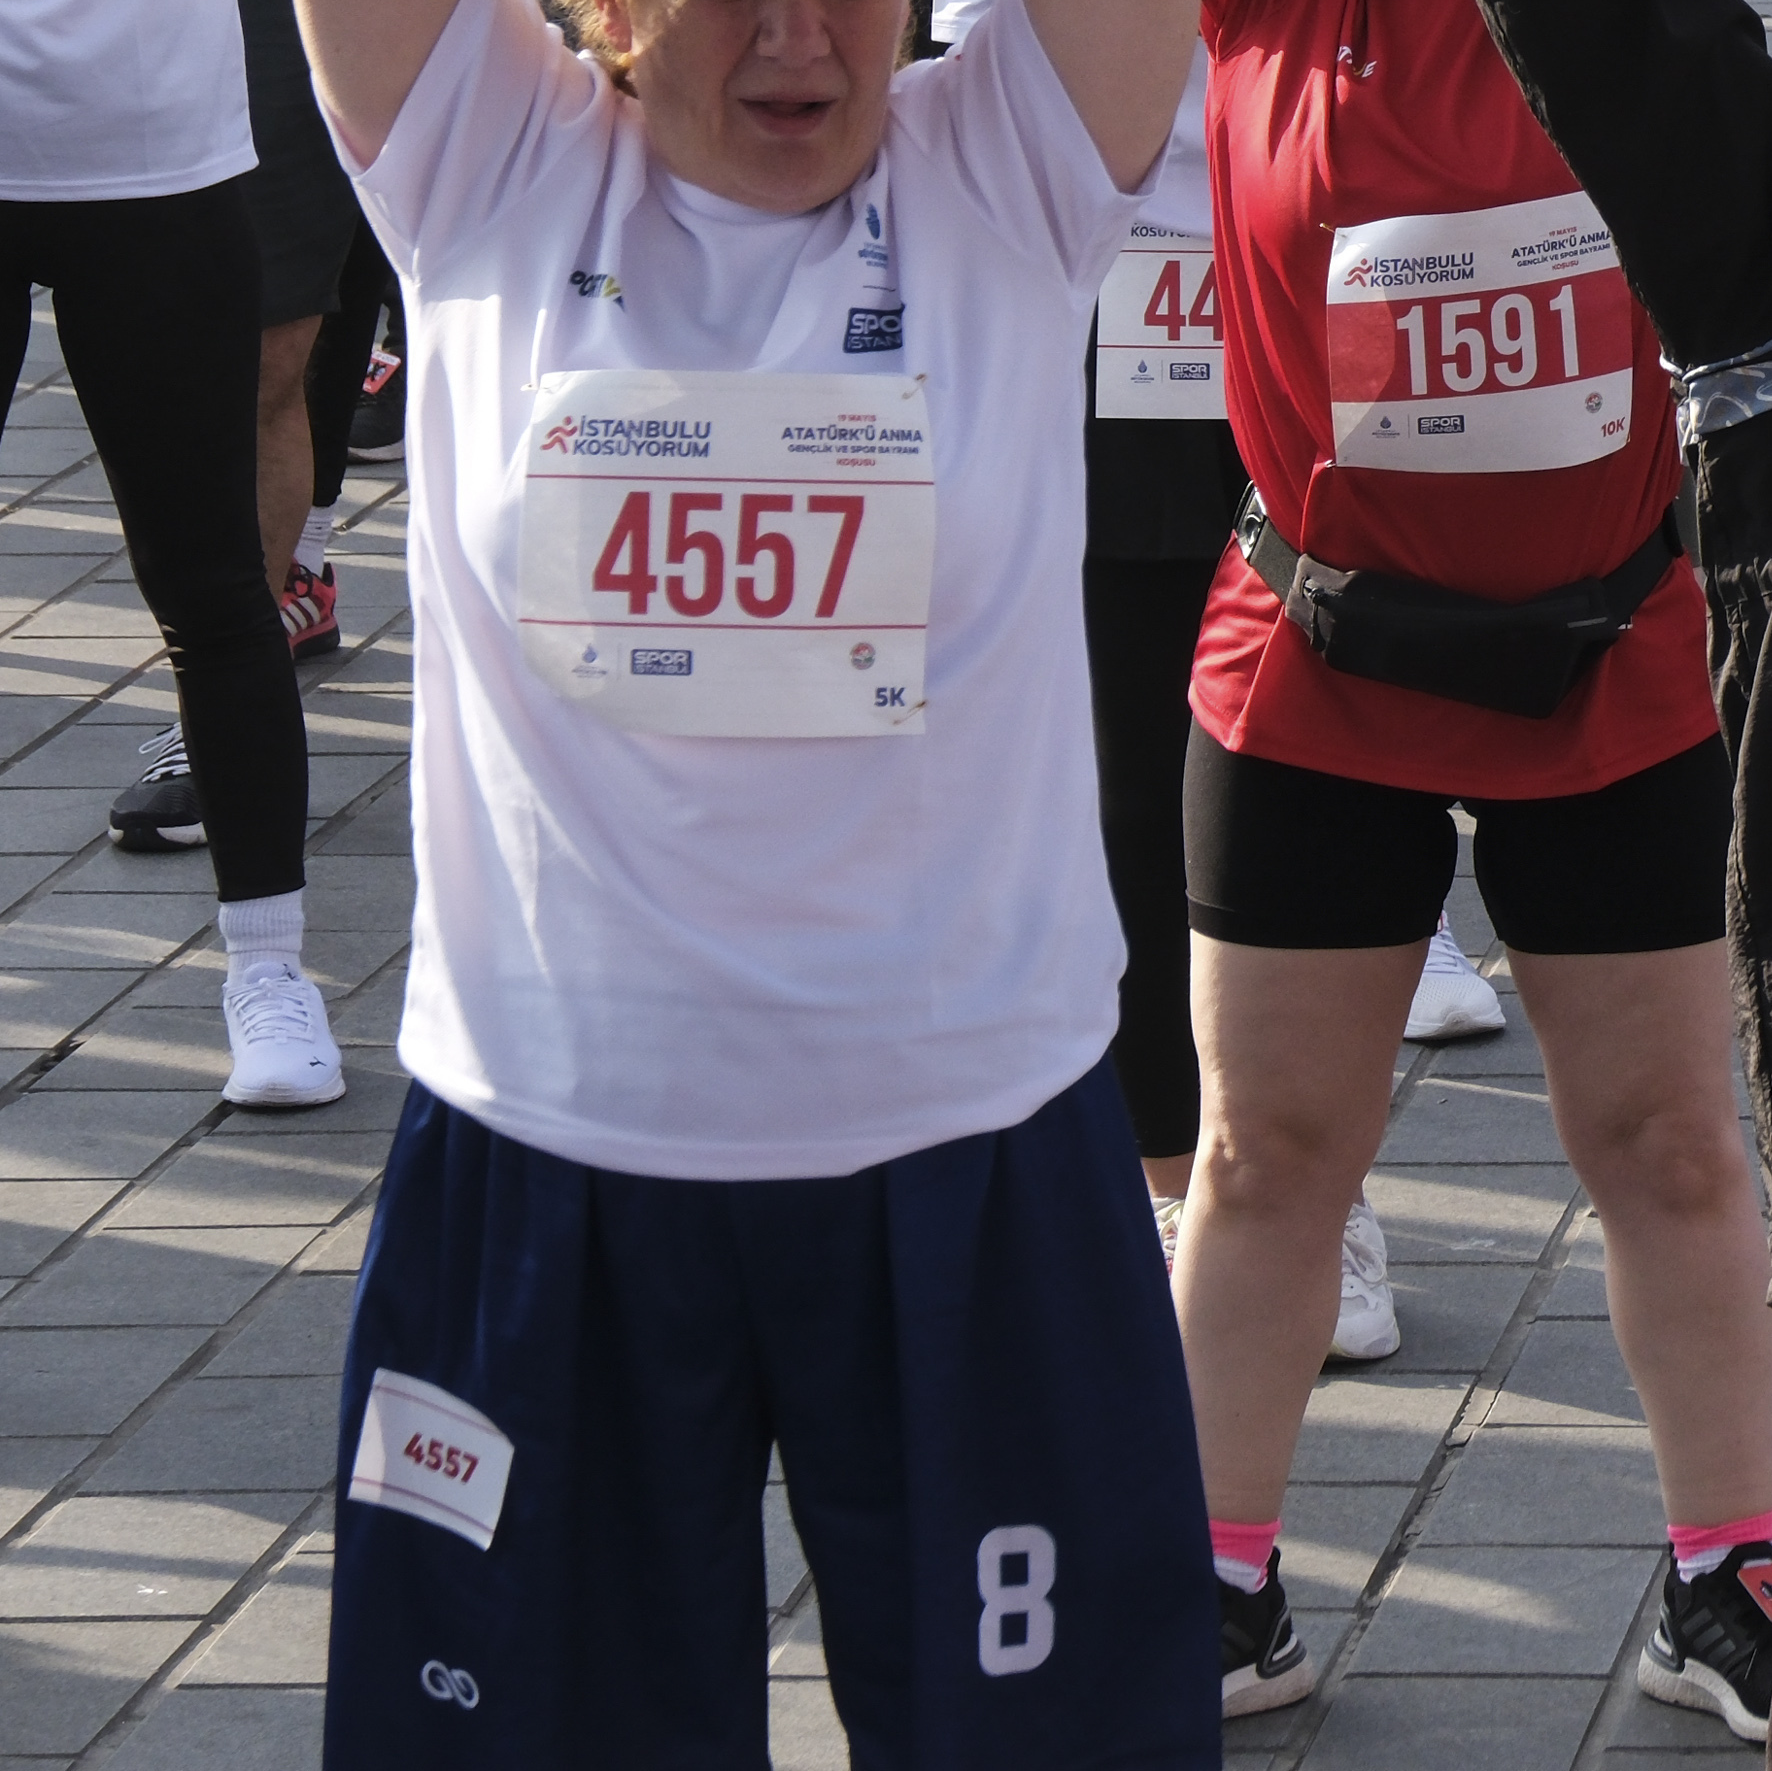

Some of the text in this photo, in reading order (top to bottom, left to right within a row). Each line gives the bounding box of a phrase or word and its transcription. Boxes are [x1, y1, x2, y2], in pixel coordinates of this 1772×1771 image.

[1373, 252, 1474, 274] İSTANBULU
[1511, 234, 1578, 259] ATATÜRK'Ü
[1516, 256, 1549, 268] GENÇLİK
[1549, 253, 1559, 261] VE
[1560, 249, 1579, 261] SPOR
[1143, 260, 1225, 342] 44
[1396, 283, 1580, 397] 1591
[1171, 364, 1207, 374] SPOR
[579, 415, 923, 443] İSTANBULU ATATÜRK'Ü ANMA
[1420, 415, 1462, 428] SPOR
[1600, 416, 1626, 439] 10K
[787, 443, 833, 455] GENÇLİK
[836, 445, 848, 454] VE
[850, 445, 876, 454] SPOR
[591, 490, 866, 619] 4557
[632, 650, 689, 665] SPOR
[874, 687, 906, 708] 5K
[403, 1430, 480, 1486] 4557
[977, 1523, 1058, 1678] 8
